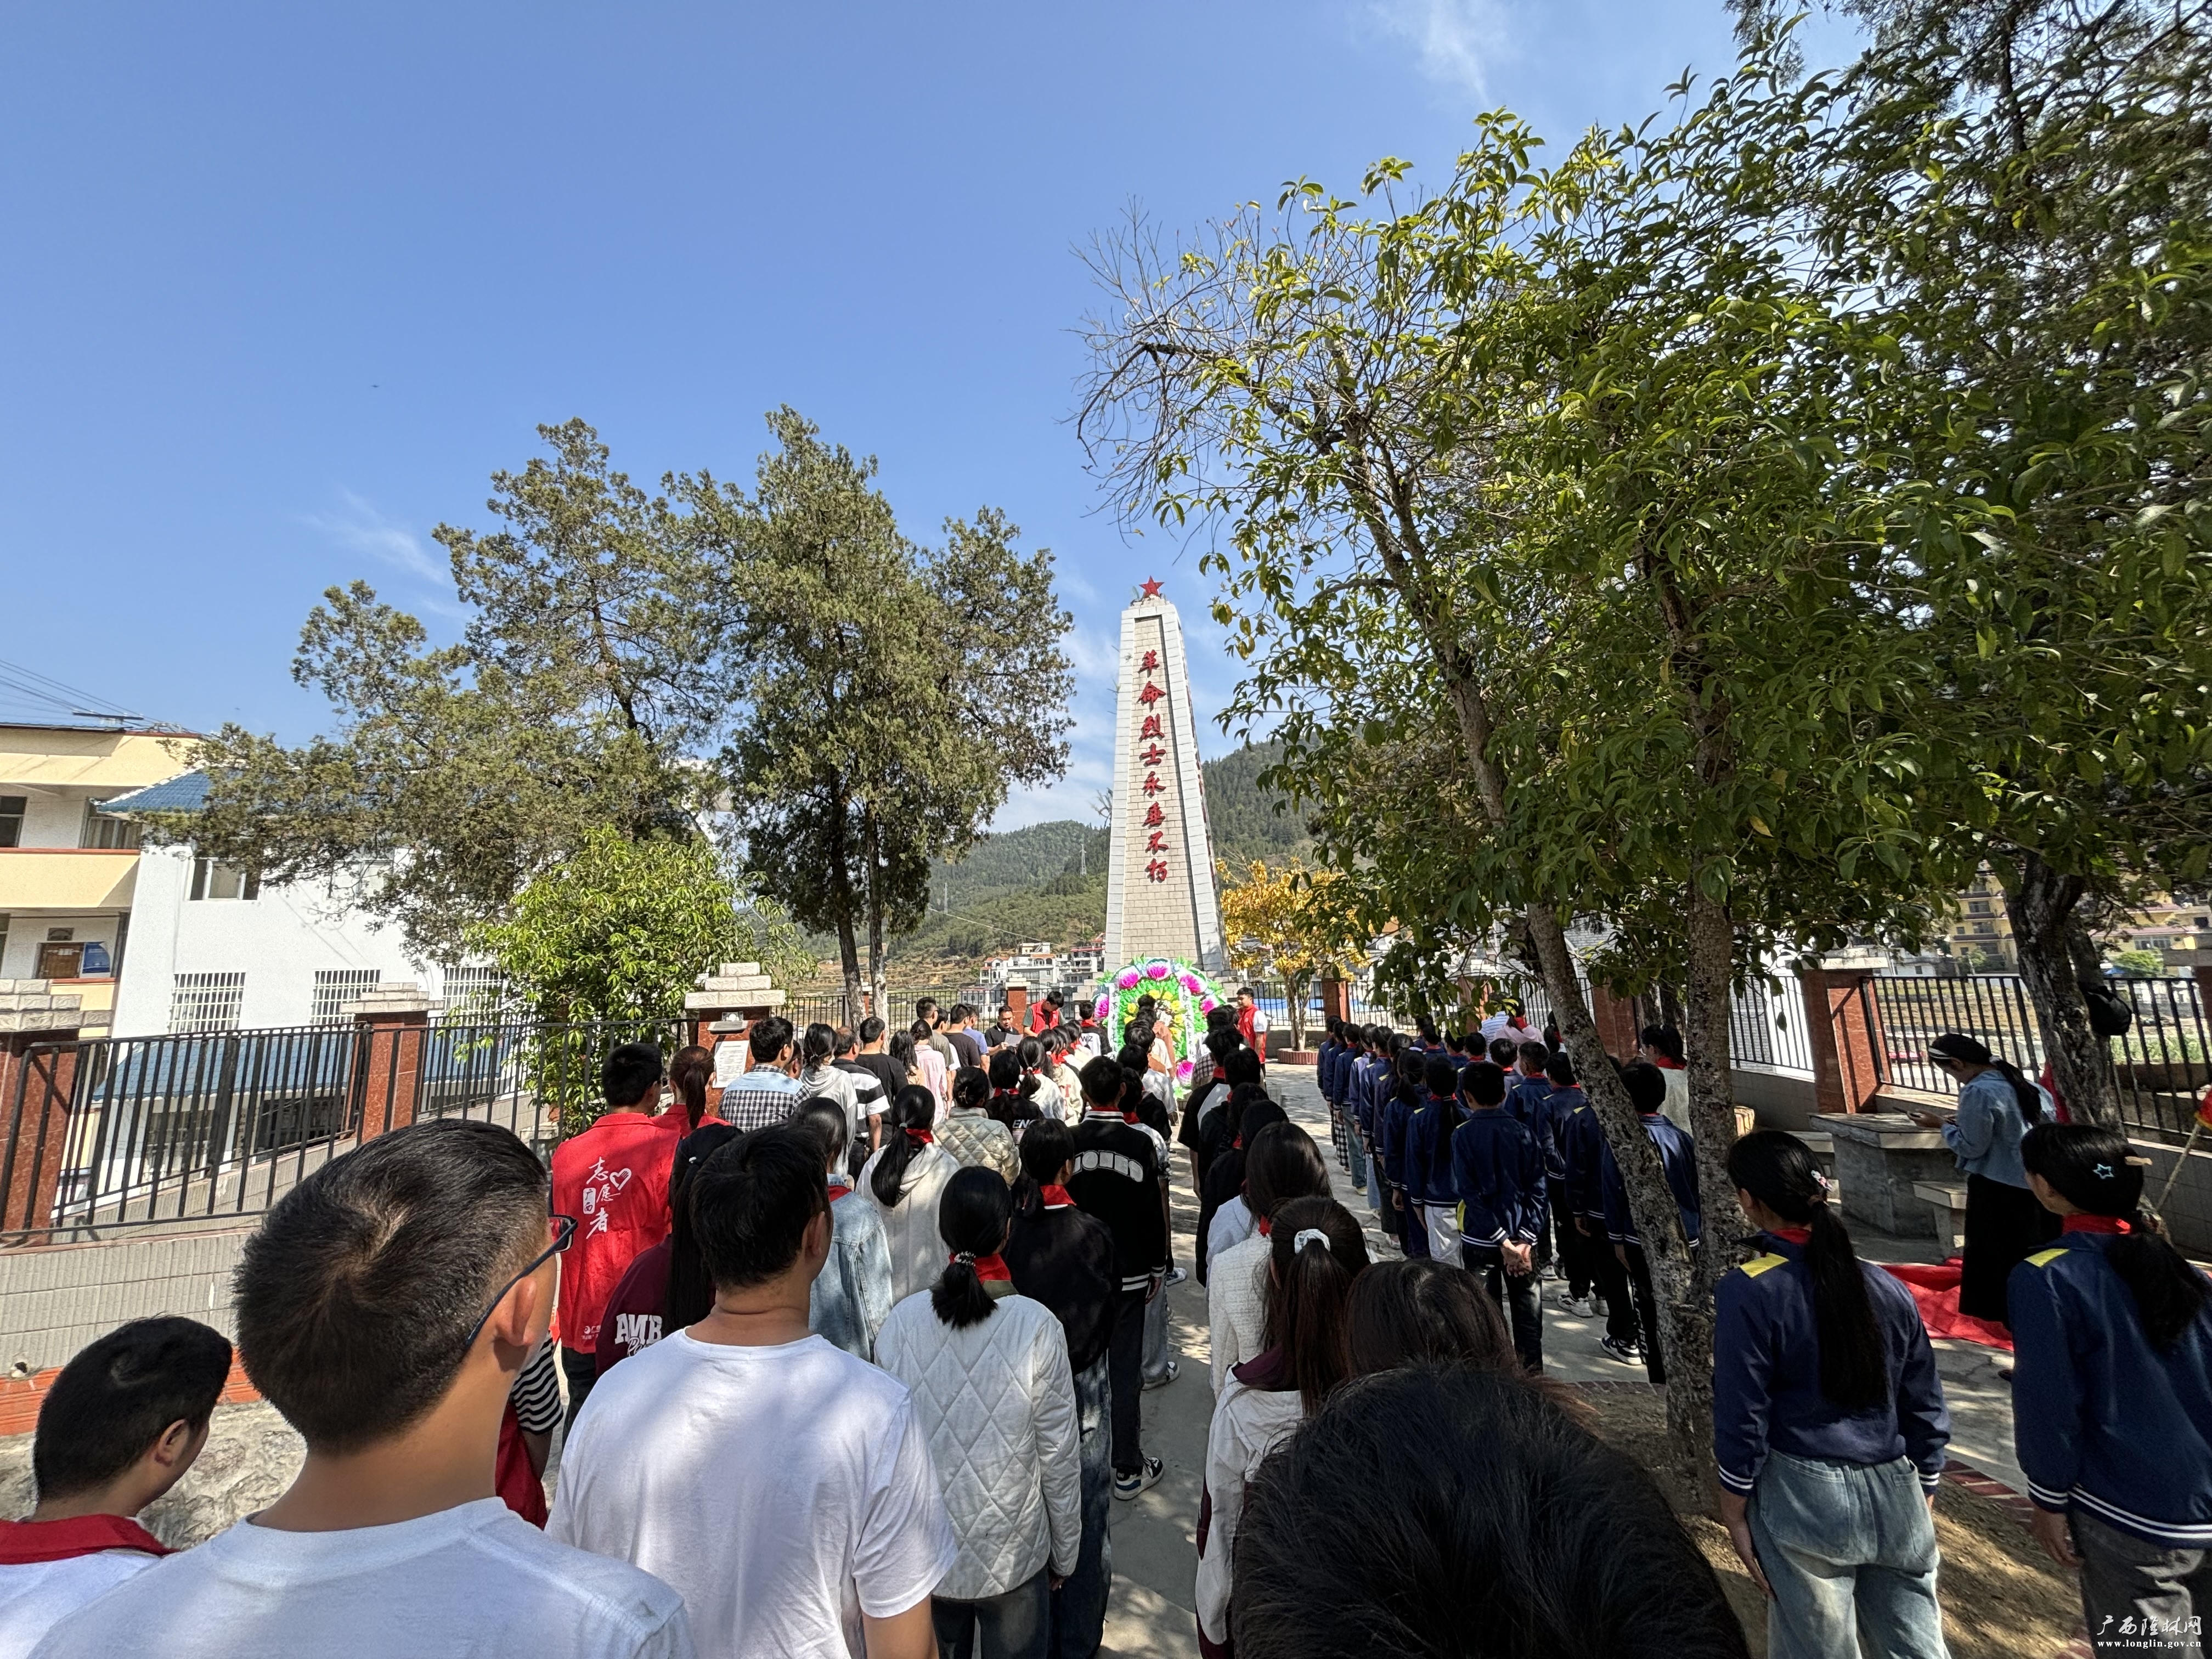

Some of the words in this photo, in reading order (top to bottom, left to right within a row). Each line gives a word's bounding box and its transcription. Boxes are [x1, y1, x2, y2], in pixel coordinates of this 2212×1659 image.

[1138, 649, 1169, 882] 革命烈士永垂不朽
[585, 1188, 594, 1212] 广西
[586, 1156, 621, 1239] 志愿者
